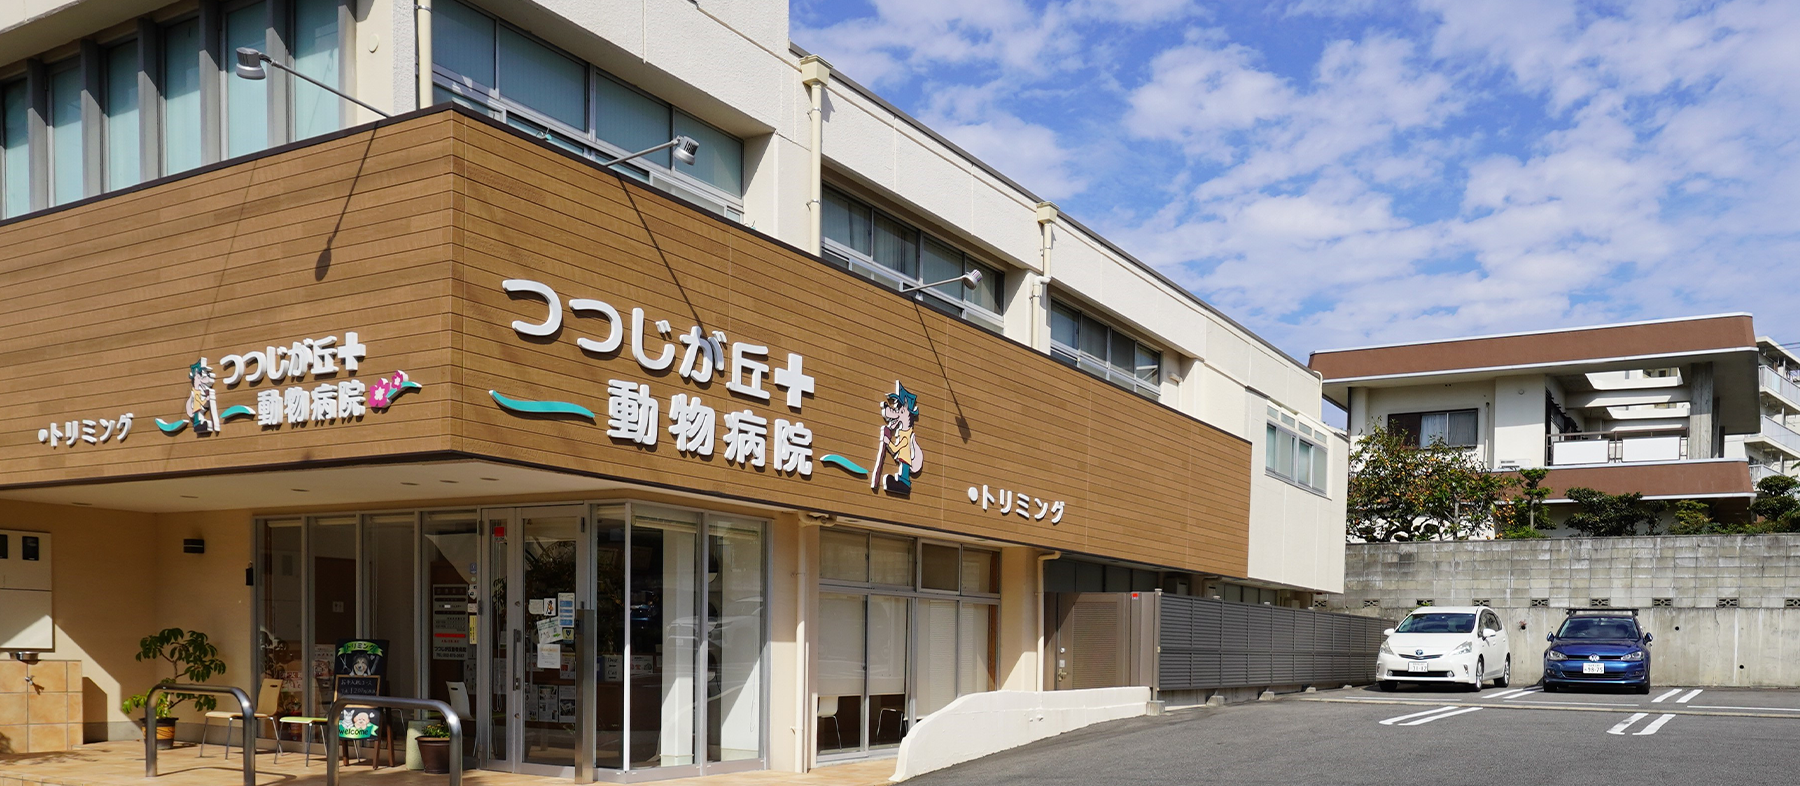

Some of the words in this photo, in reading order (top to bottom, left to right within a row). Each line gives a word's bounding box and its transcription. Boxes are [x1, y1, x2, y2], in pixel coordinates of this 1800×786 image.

[219, 335, 339, 385] つつじが丘
[501, 278, 770, 400] つつじが丘
[257, 379, 367, 427] 動物病院
[607, 378, 813, 476] 動物病院
[50, 412, 135, 447] トリミング
[980, 484, 1066, 525] トリミング
[345, 642, 377, 651] トリミング
